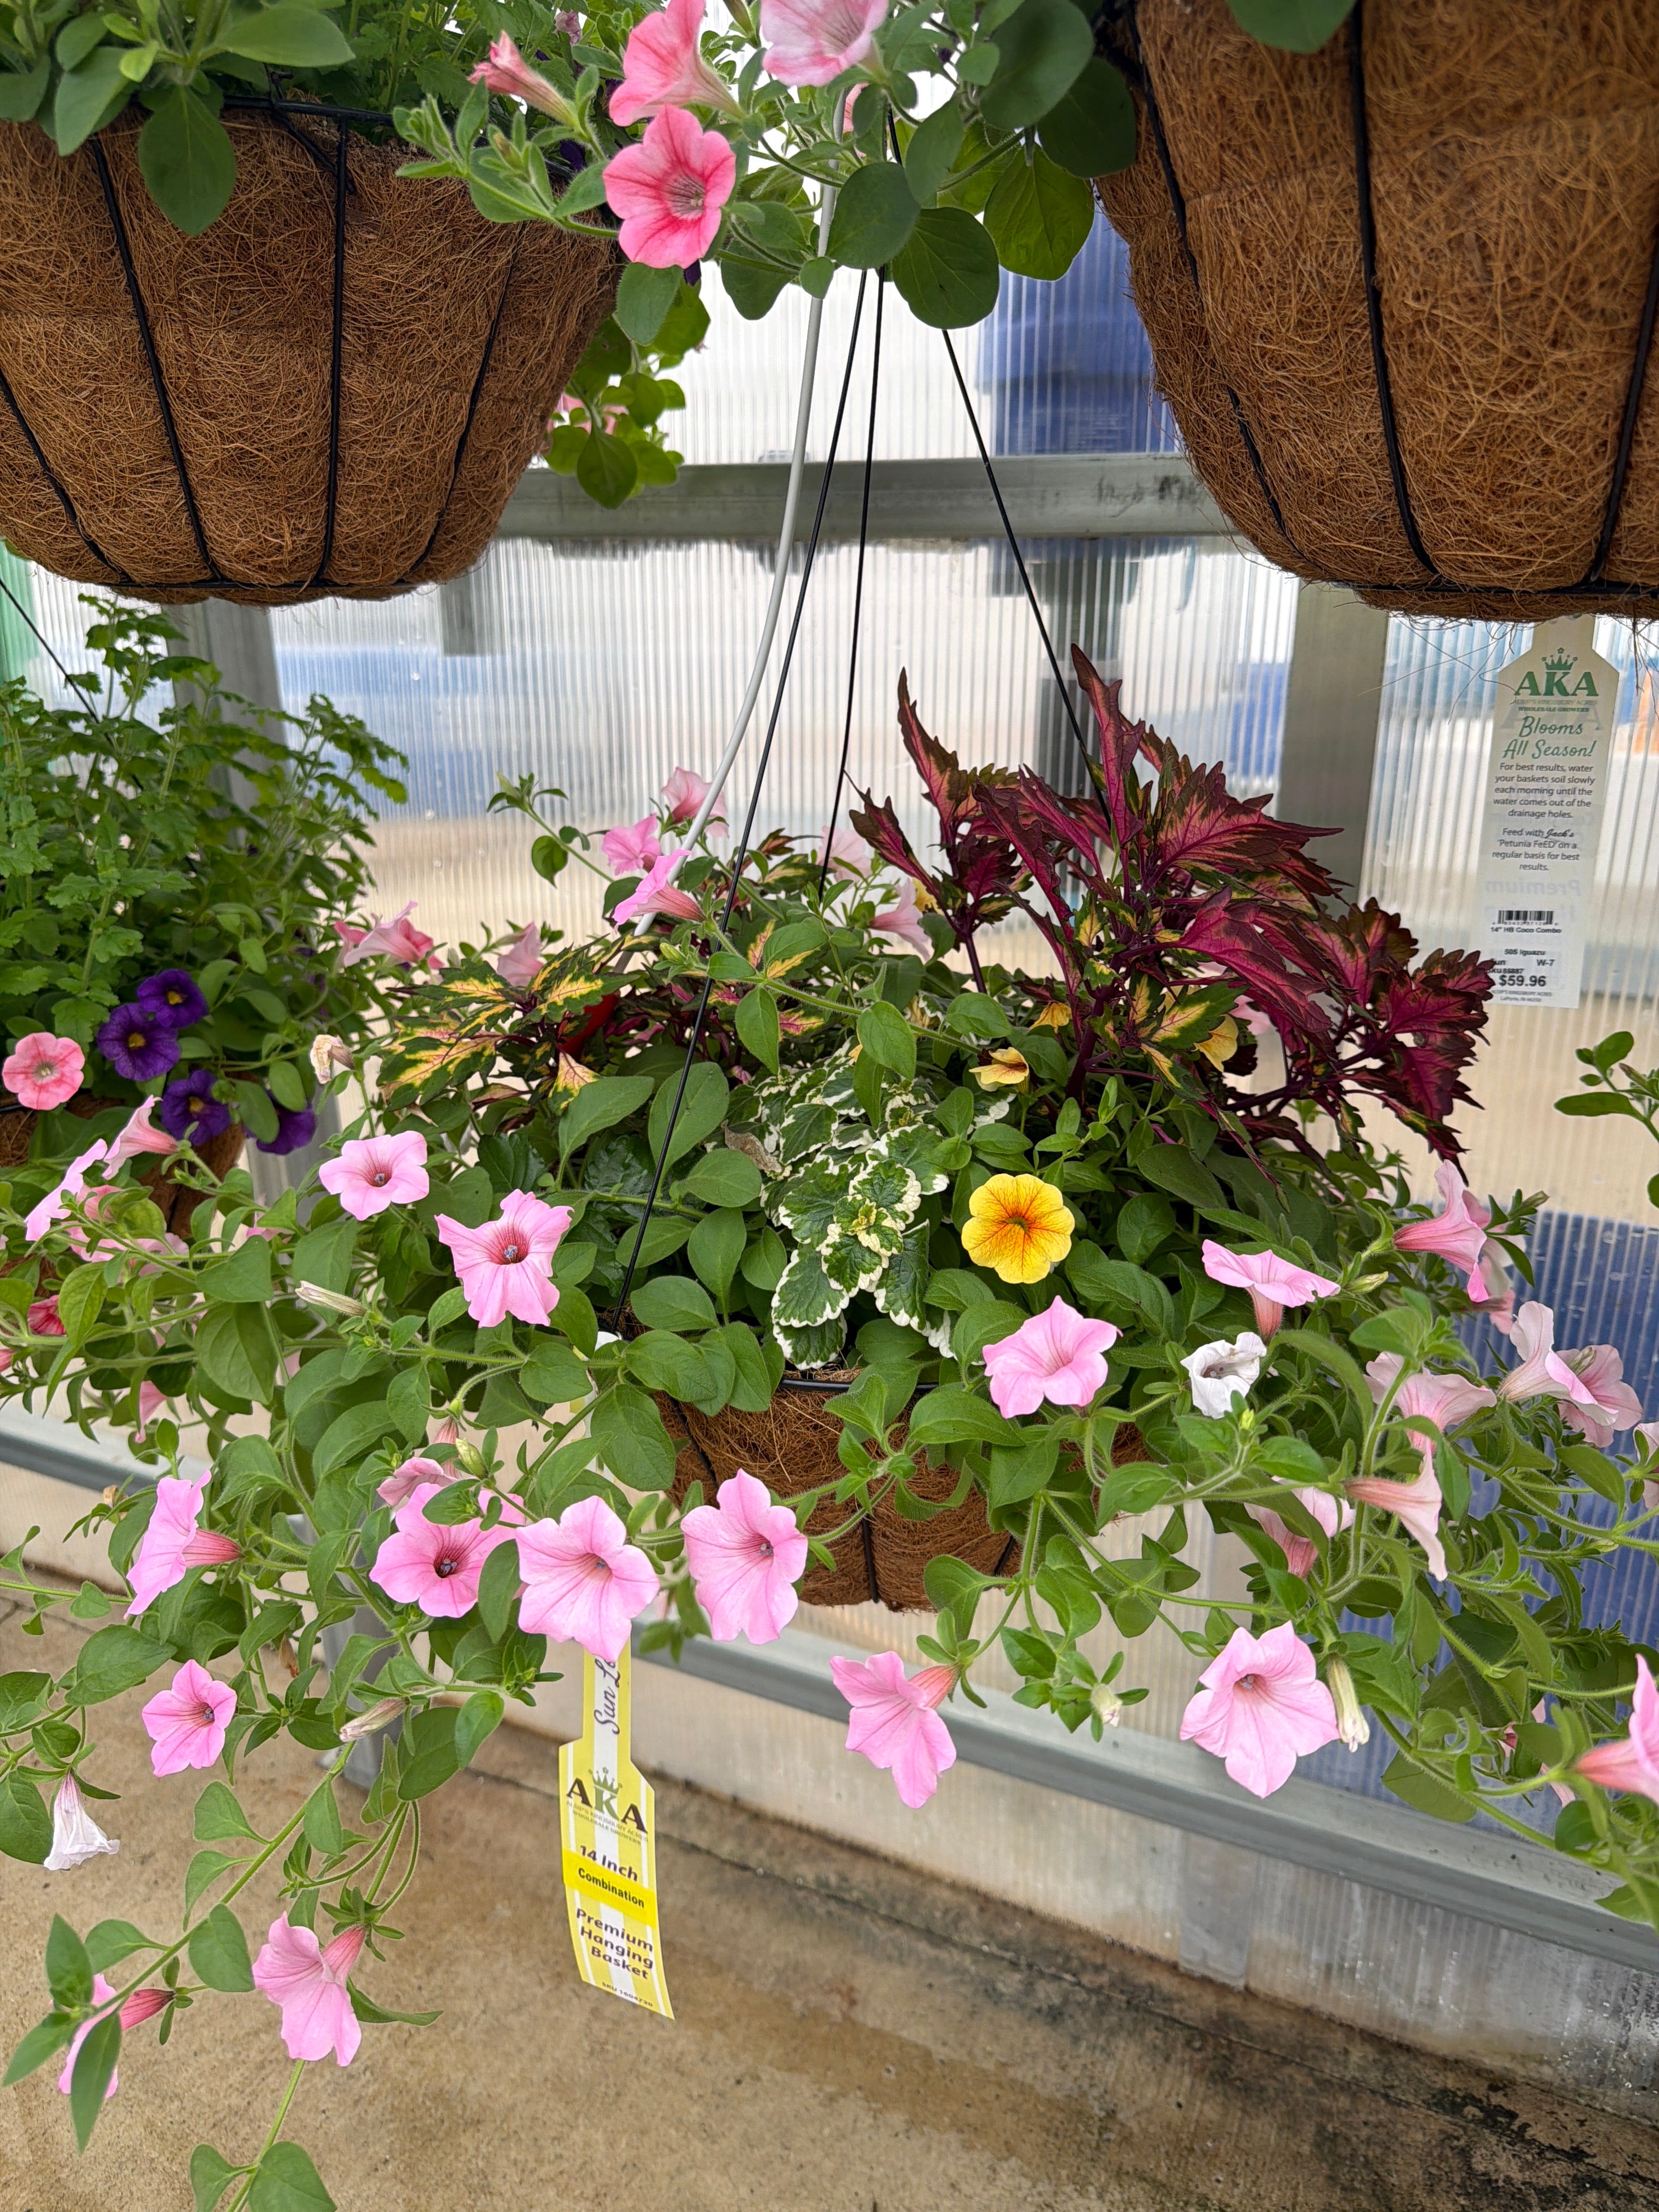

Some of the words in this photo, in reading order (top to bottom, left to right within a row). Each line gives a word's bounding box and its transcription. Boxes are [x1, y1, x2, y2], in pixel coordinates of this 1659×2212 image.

[1514, 672, 1599, 697] AKA
[1519, 715, 1583, 737] Blooms
[1502, 739, 1529, 759] All
[1532, 739, 1597, 759] Season!
[1536, 764, 1566, 772] results,
[1494, 775, 1515, 783] your
[1516, 775, 1549, 783] baskets
[1567, 776, 1595, 786] slowly
[1494, 786, 1515, 794] each
[1516, 787, 1554, 796] morning
[1508, 809, 1547, 819] drainage
[1548, 810, 1573, 818] holes.
[1502, 828, 1524, 836] Feed
[1525, 828, 1544, 837] with
[1492, 851, 1522, 860] regular
[1547, 851, 1560, 860] for
[1561, 853, 1580, 861] best
[1519, 863, 1549, 871] results.
[1498, 974, 1547, 987] $59.96
[594, 1686, 620, 1735] Sun
[566, 1778, 648, 1834] AKA
[580, 1845, 597, 1861] 14
[601, 1855, 638, 1882] Inch
[578, 1867, 645, 1909] Combination
[576, 1908, 653, 1952] Premium
[580, 1926, 653, 1970] Hanging
[591, 1945, 649, 1979] Basket
